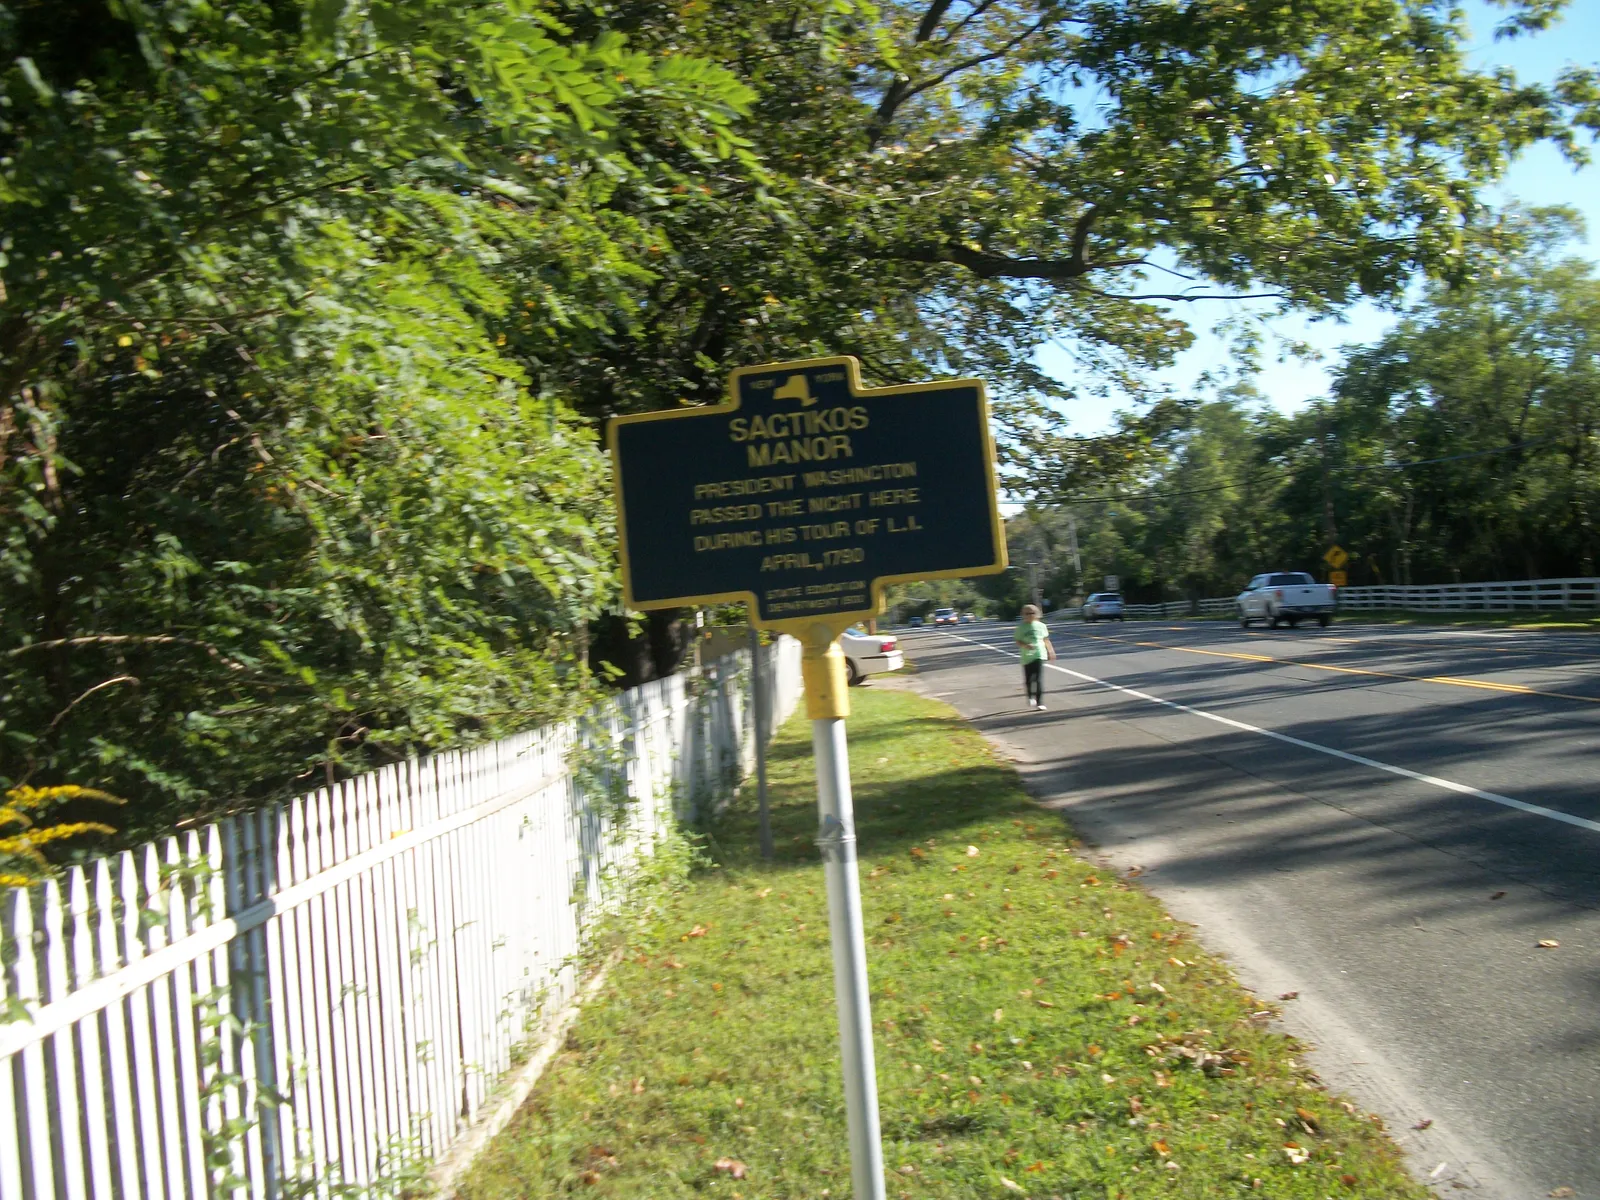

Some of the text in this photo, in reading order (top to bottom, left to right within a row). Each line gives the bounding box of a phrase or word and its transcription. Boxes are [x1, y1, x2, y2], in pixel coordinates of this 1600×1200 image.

[729, 407, 869, 442] SACTIKOS
[747, 435, 853, 467] MANOR
[694, 462, 918, 499] PRESIDENT WASHINGTON
[690, 488, 920, 525] PASSED THE NIGHT HERE
[694, 530, 762, 551] DURING
[765, 526, 797, 544] HIS
[798, 521, 850, 541] TOUR
[855, 518, 880, 535] OF
